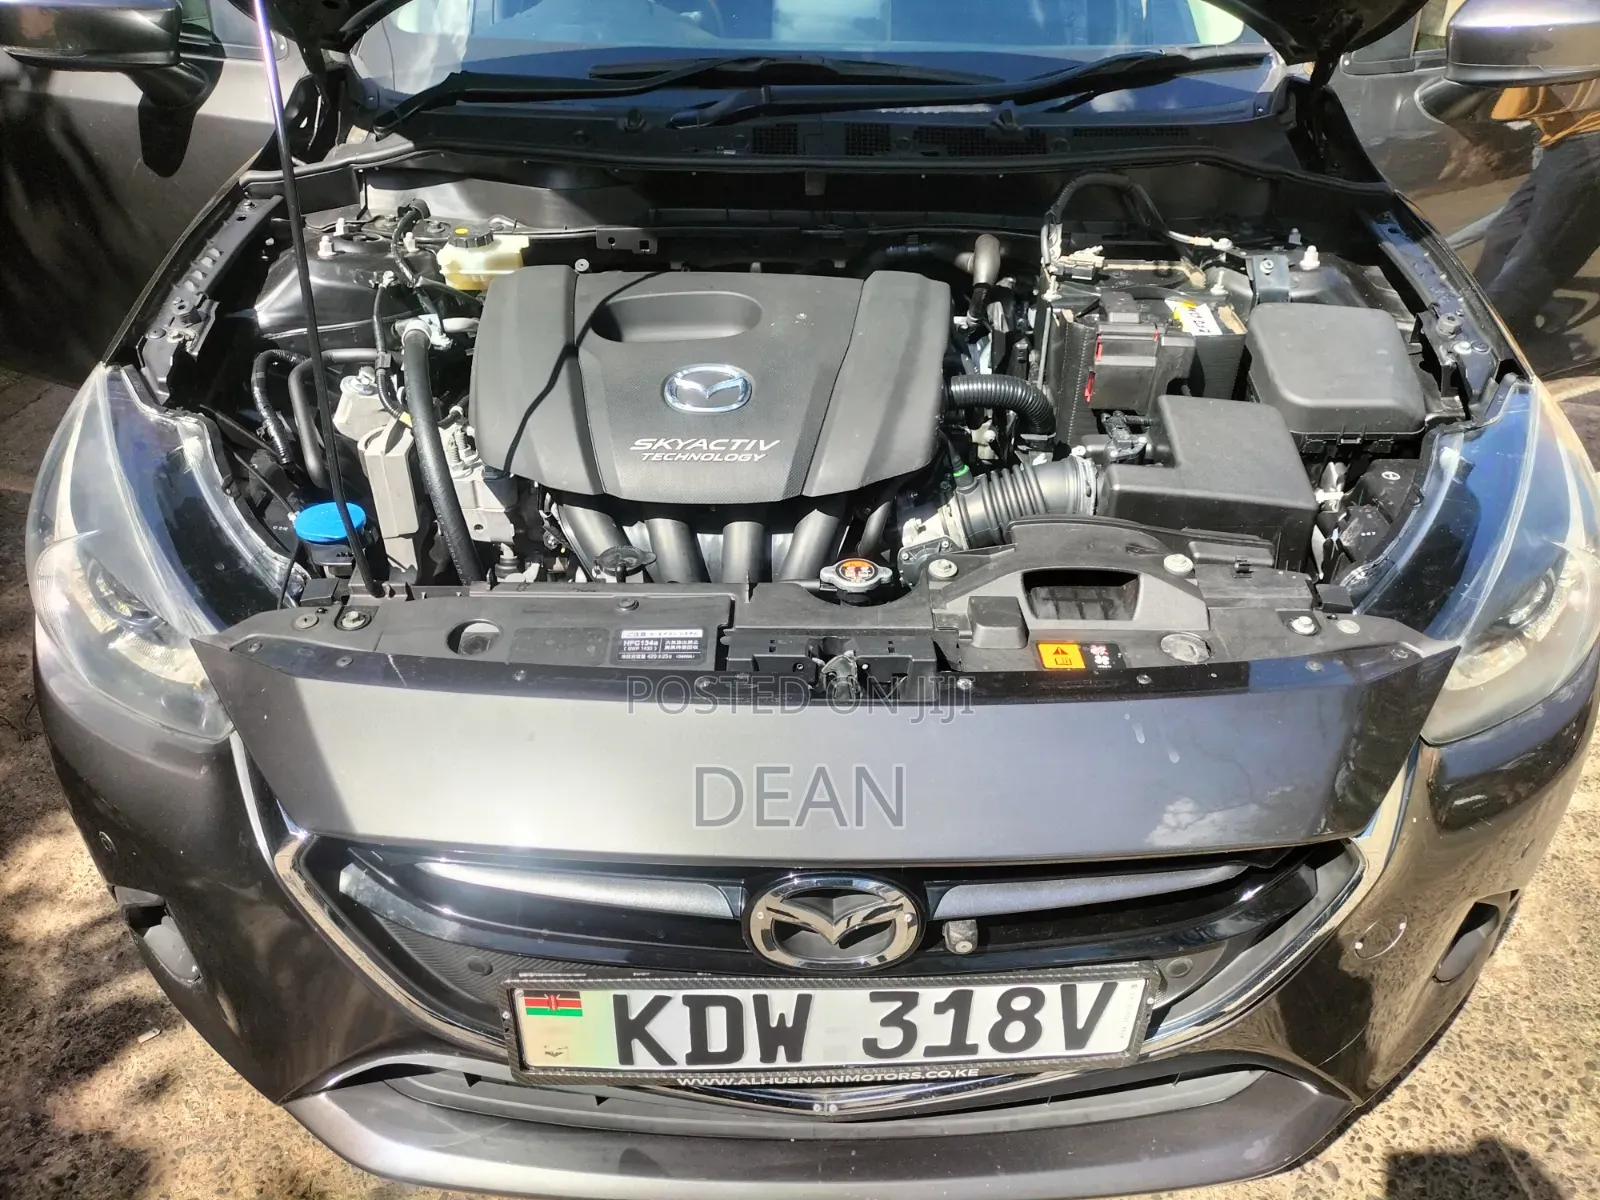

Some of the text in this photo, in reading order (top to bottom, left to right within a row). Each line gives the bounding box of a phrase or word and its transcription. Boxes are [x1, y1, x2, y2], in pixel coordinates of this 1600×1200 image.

[630, 438, 781, 451] SKYACTIV
[641, 452, 767, 462] TECHNOLOGY
[612, 992, 813, 1066] KDW
[862, 981, 1119, 1059] 318V
[677, 1068, 980, 1086] WWW.ALHUSNAINMOTORS.CO.KE
